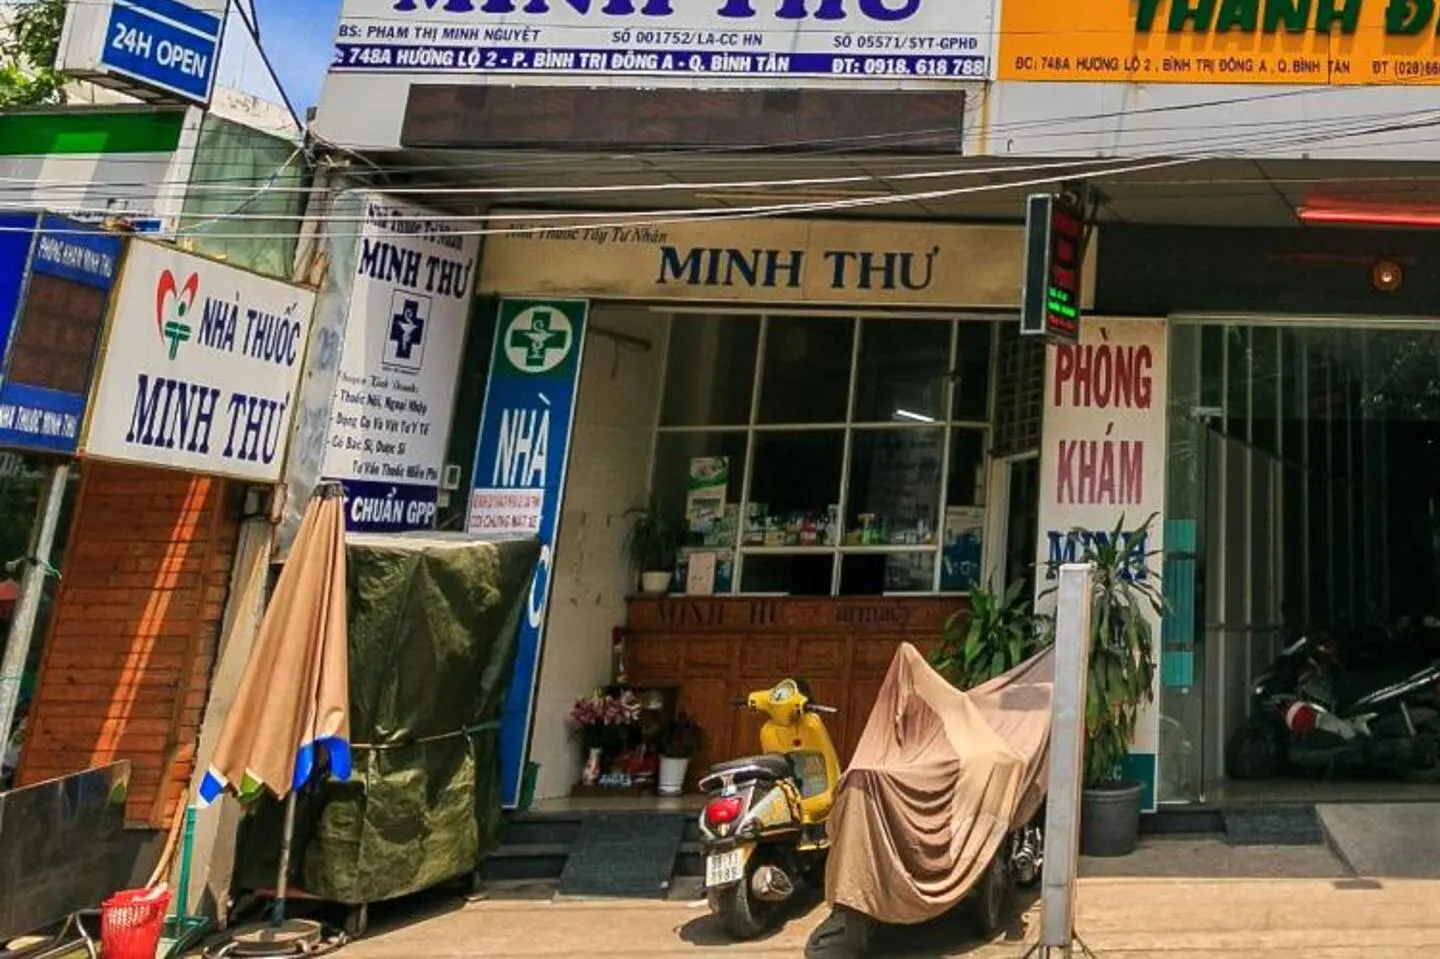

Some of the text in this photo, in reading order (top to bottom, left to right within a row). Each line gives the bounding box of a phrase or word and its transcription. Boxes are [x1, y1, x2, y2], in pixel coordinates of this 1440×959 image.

[112, 22, 208, 79] 24H OPEN
[338, 25, 362, 38] BS:
[441, 27, 480, 40] MINH
[742, 34, 764, 46] HN
[350, 48, 391, 65] 748A
[485, 53, 497, 68] 2
[511, 53, 529, 69] P.
[579, 51, 607, 72] TRỊ
[661, 55, 674, 71] A
[688, 55, 705, 73] Q.
[711, 52, 752, 73] BÌNH
[831, 57, 860, 75] ĐT:
[864, 58, 907, 75] 0918.
[915, 58, 948, 75] 618
[952, 58, 985, 76] 788
[1143, 57, 1151, 71] 2
[358, 238, 473, 299] MINH THƯ
[655, 244, 942, 291] MINH THƯ
[197, 290, 302, 367] NHÀ THUỐC
[1053, 327, 1153, 410] PHÒNG
[125, 373, 290, 465] MINH THƯ
[491, 391, 552, 490] NHÀ
[1056, 421, 1145, 505] KHÁM
[350, 486, 404, 524] CHUẨN
[405, 499, 436, 526] GPP
